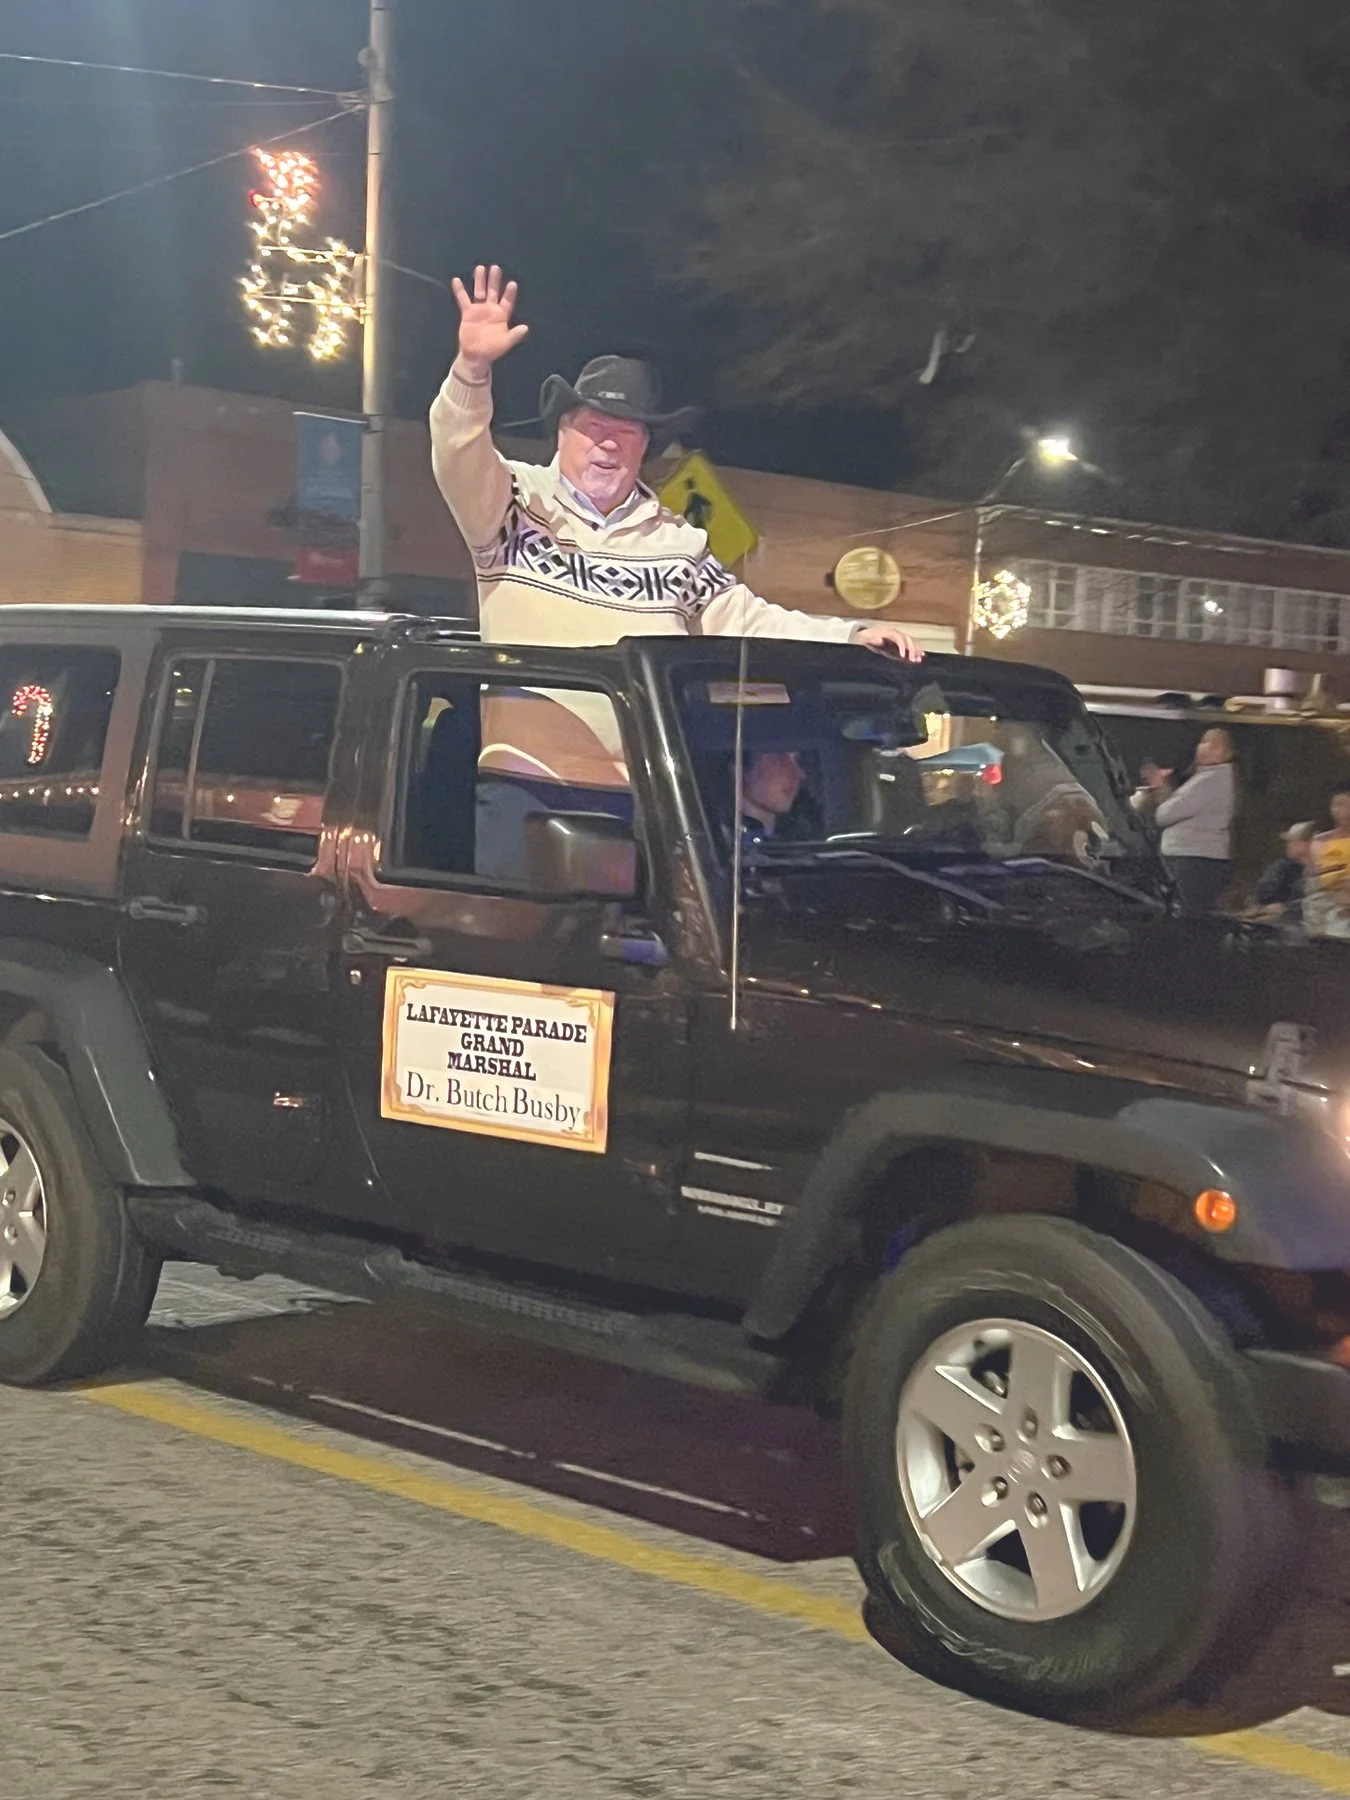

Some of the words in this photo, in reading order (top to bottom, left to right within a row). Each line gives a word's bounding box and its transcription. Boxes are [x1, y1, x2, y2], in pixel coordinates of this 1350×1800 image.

[406, 1003, 507, 1033] LAFAYETTE
[511, 1016, 587, 1043] PARADE
[461, 1033, 524, 1058] GRAND
[447, 1052, 536, 1081] MARSHAL
[406, 1071, 439, 1102] Dr.
[447, 1078, 508, 1113] Butch
[512, 1087, 581, 1130] Busby
